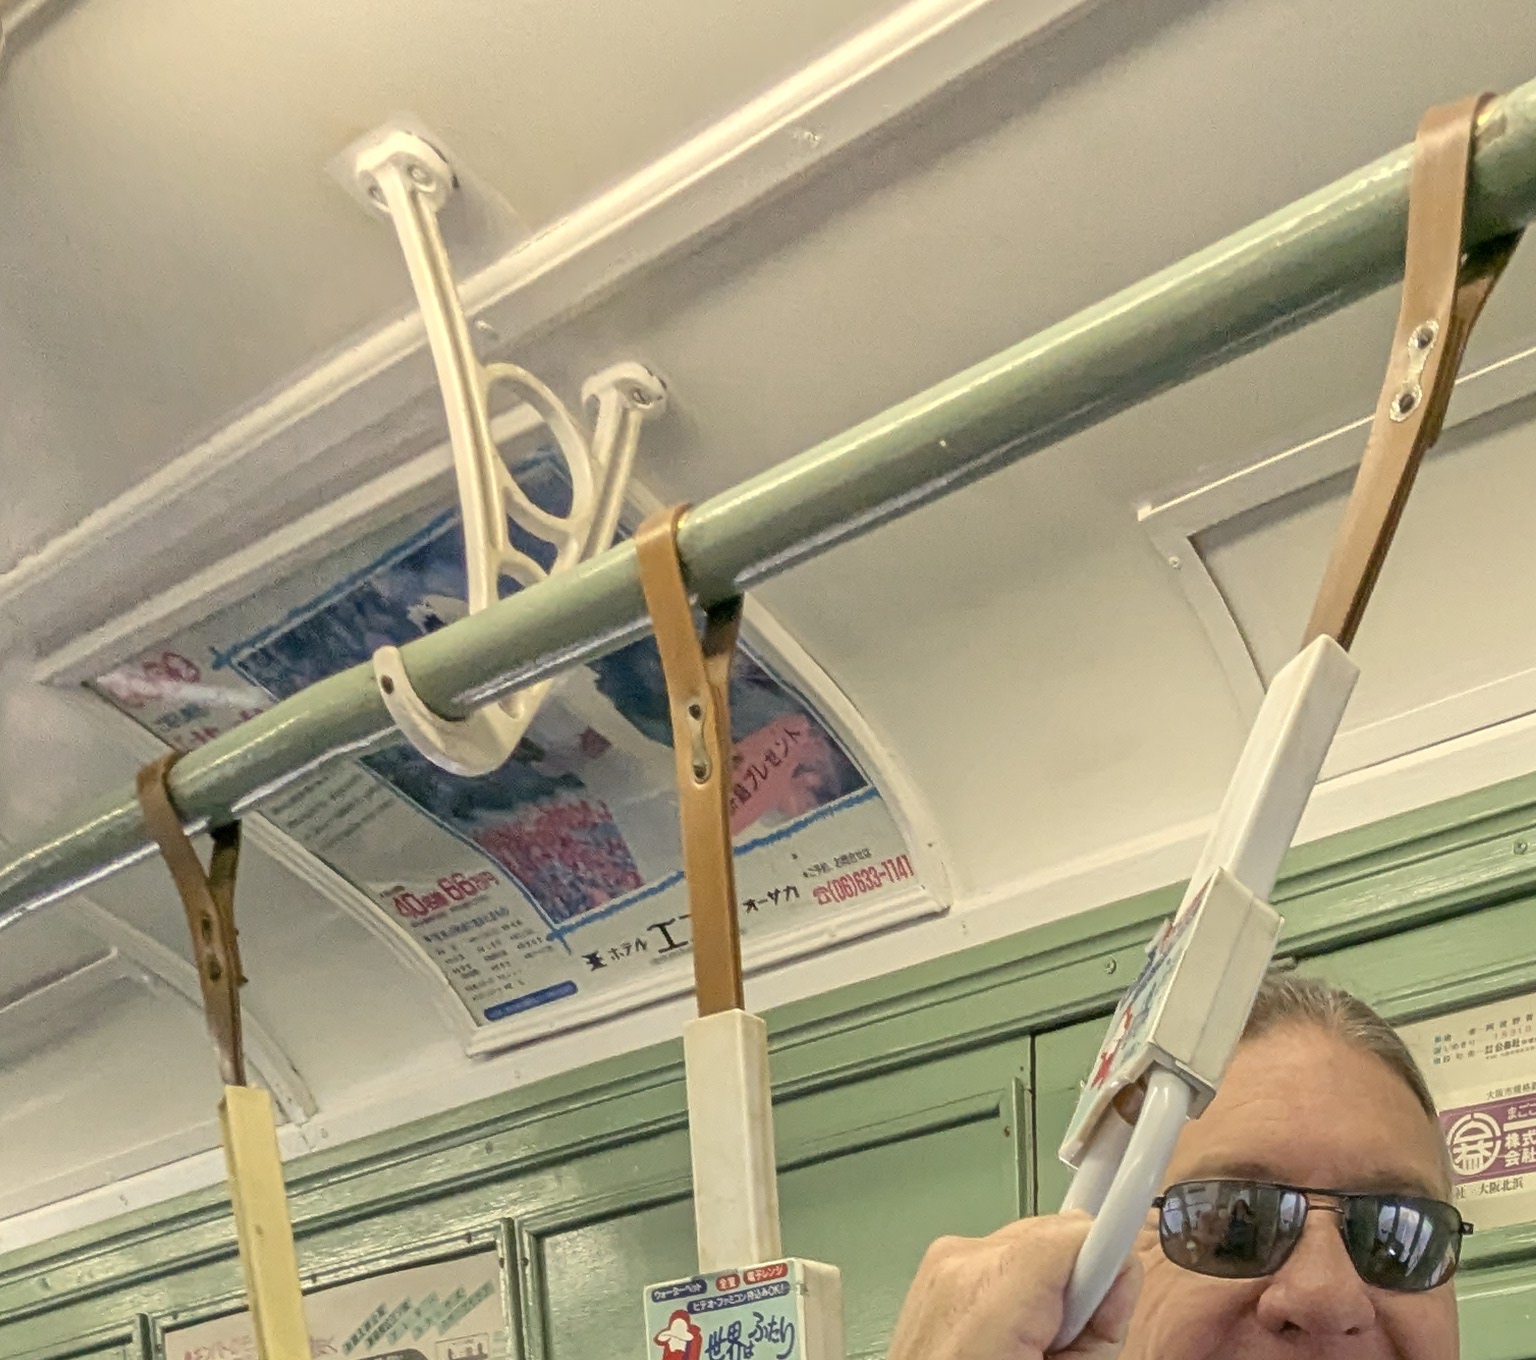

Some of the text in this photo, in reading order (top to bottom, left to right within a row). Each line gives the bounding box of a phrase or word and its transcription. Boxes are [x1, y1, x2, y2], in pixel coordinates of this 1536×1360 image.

[610, 937, 648, 961] ホテル
[743, 886, 800, 913] オーサカ
